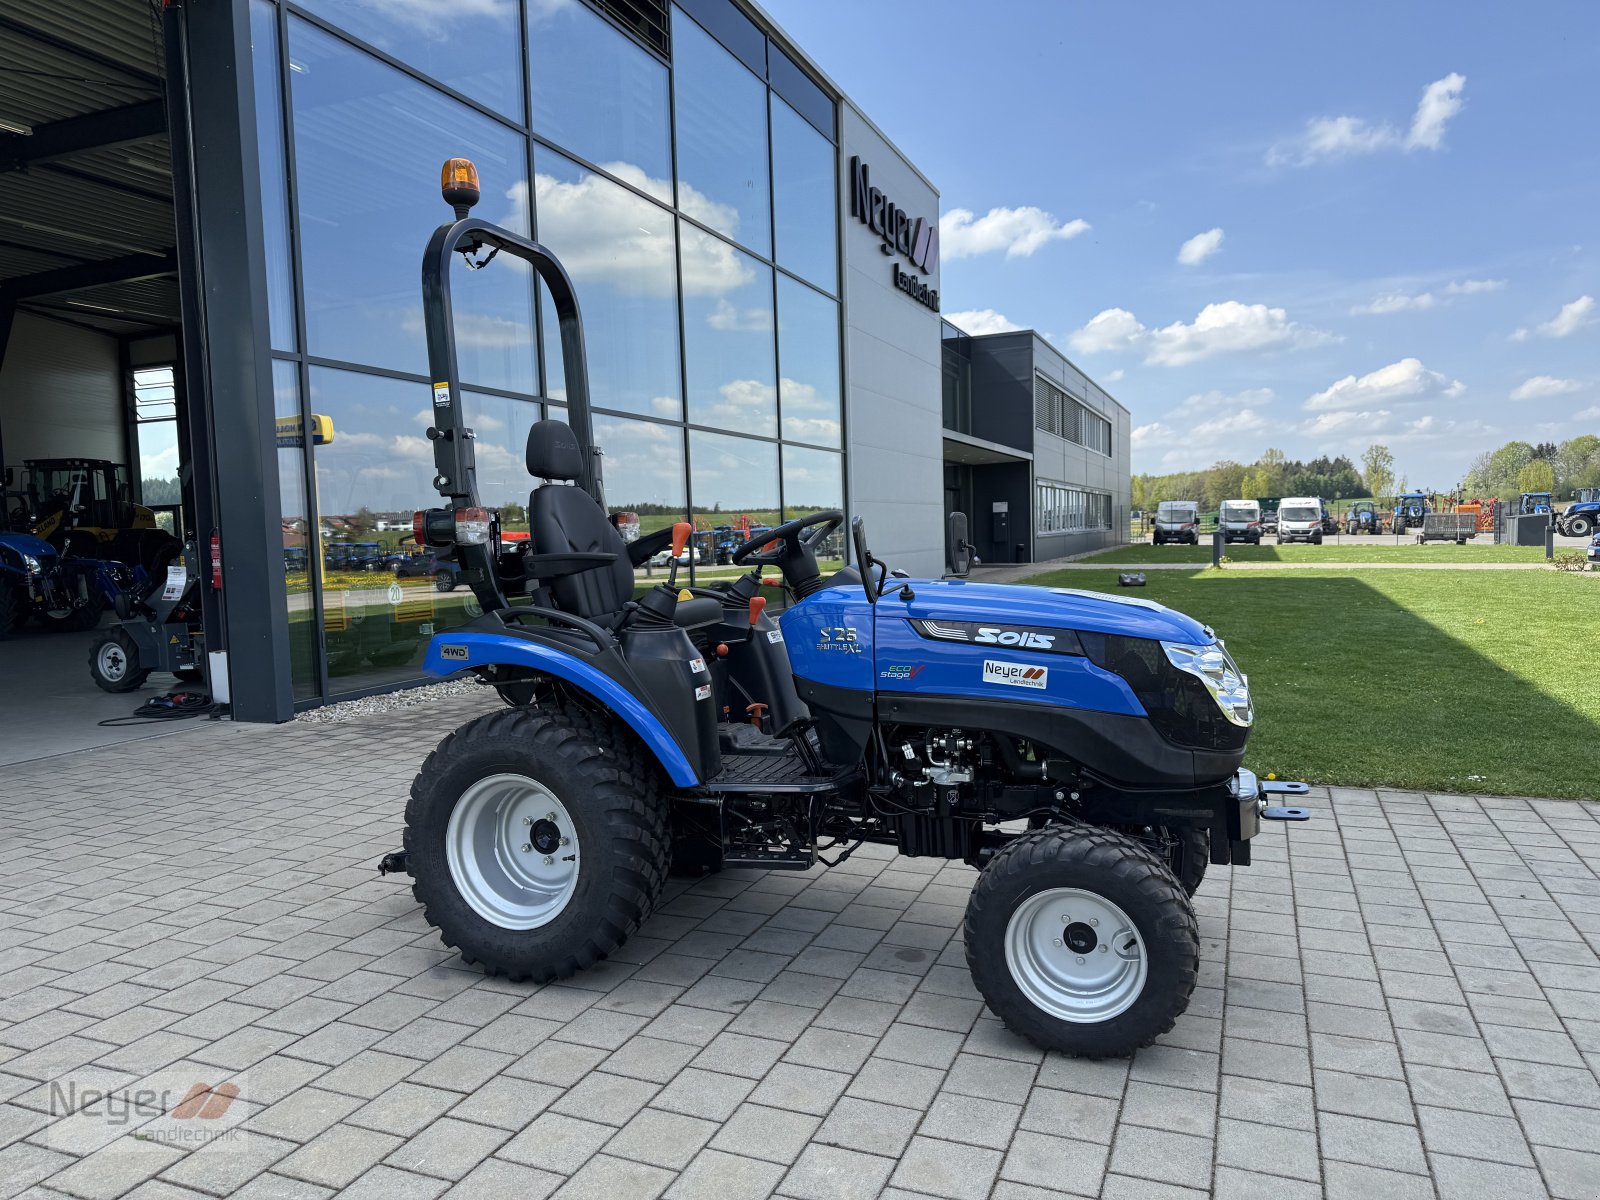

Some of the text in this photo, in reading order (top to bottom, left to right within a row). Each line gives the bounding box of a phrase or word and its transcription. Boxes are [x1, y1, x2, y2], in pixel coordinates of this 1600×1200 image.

[850, 155, 913, 257] Neyer
[390, 586, 400, 601] 20
[443, 648, 466, 656] 4WD
[880, 671, 911, 679] Stage
[985, 662, 1023, 678] Neyer
[1009, 678, 1044, 688] Landtechnik
